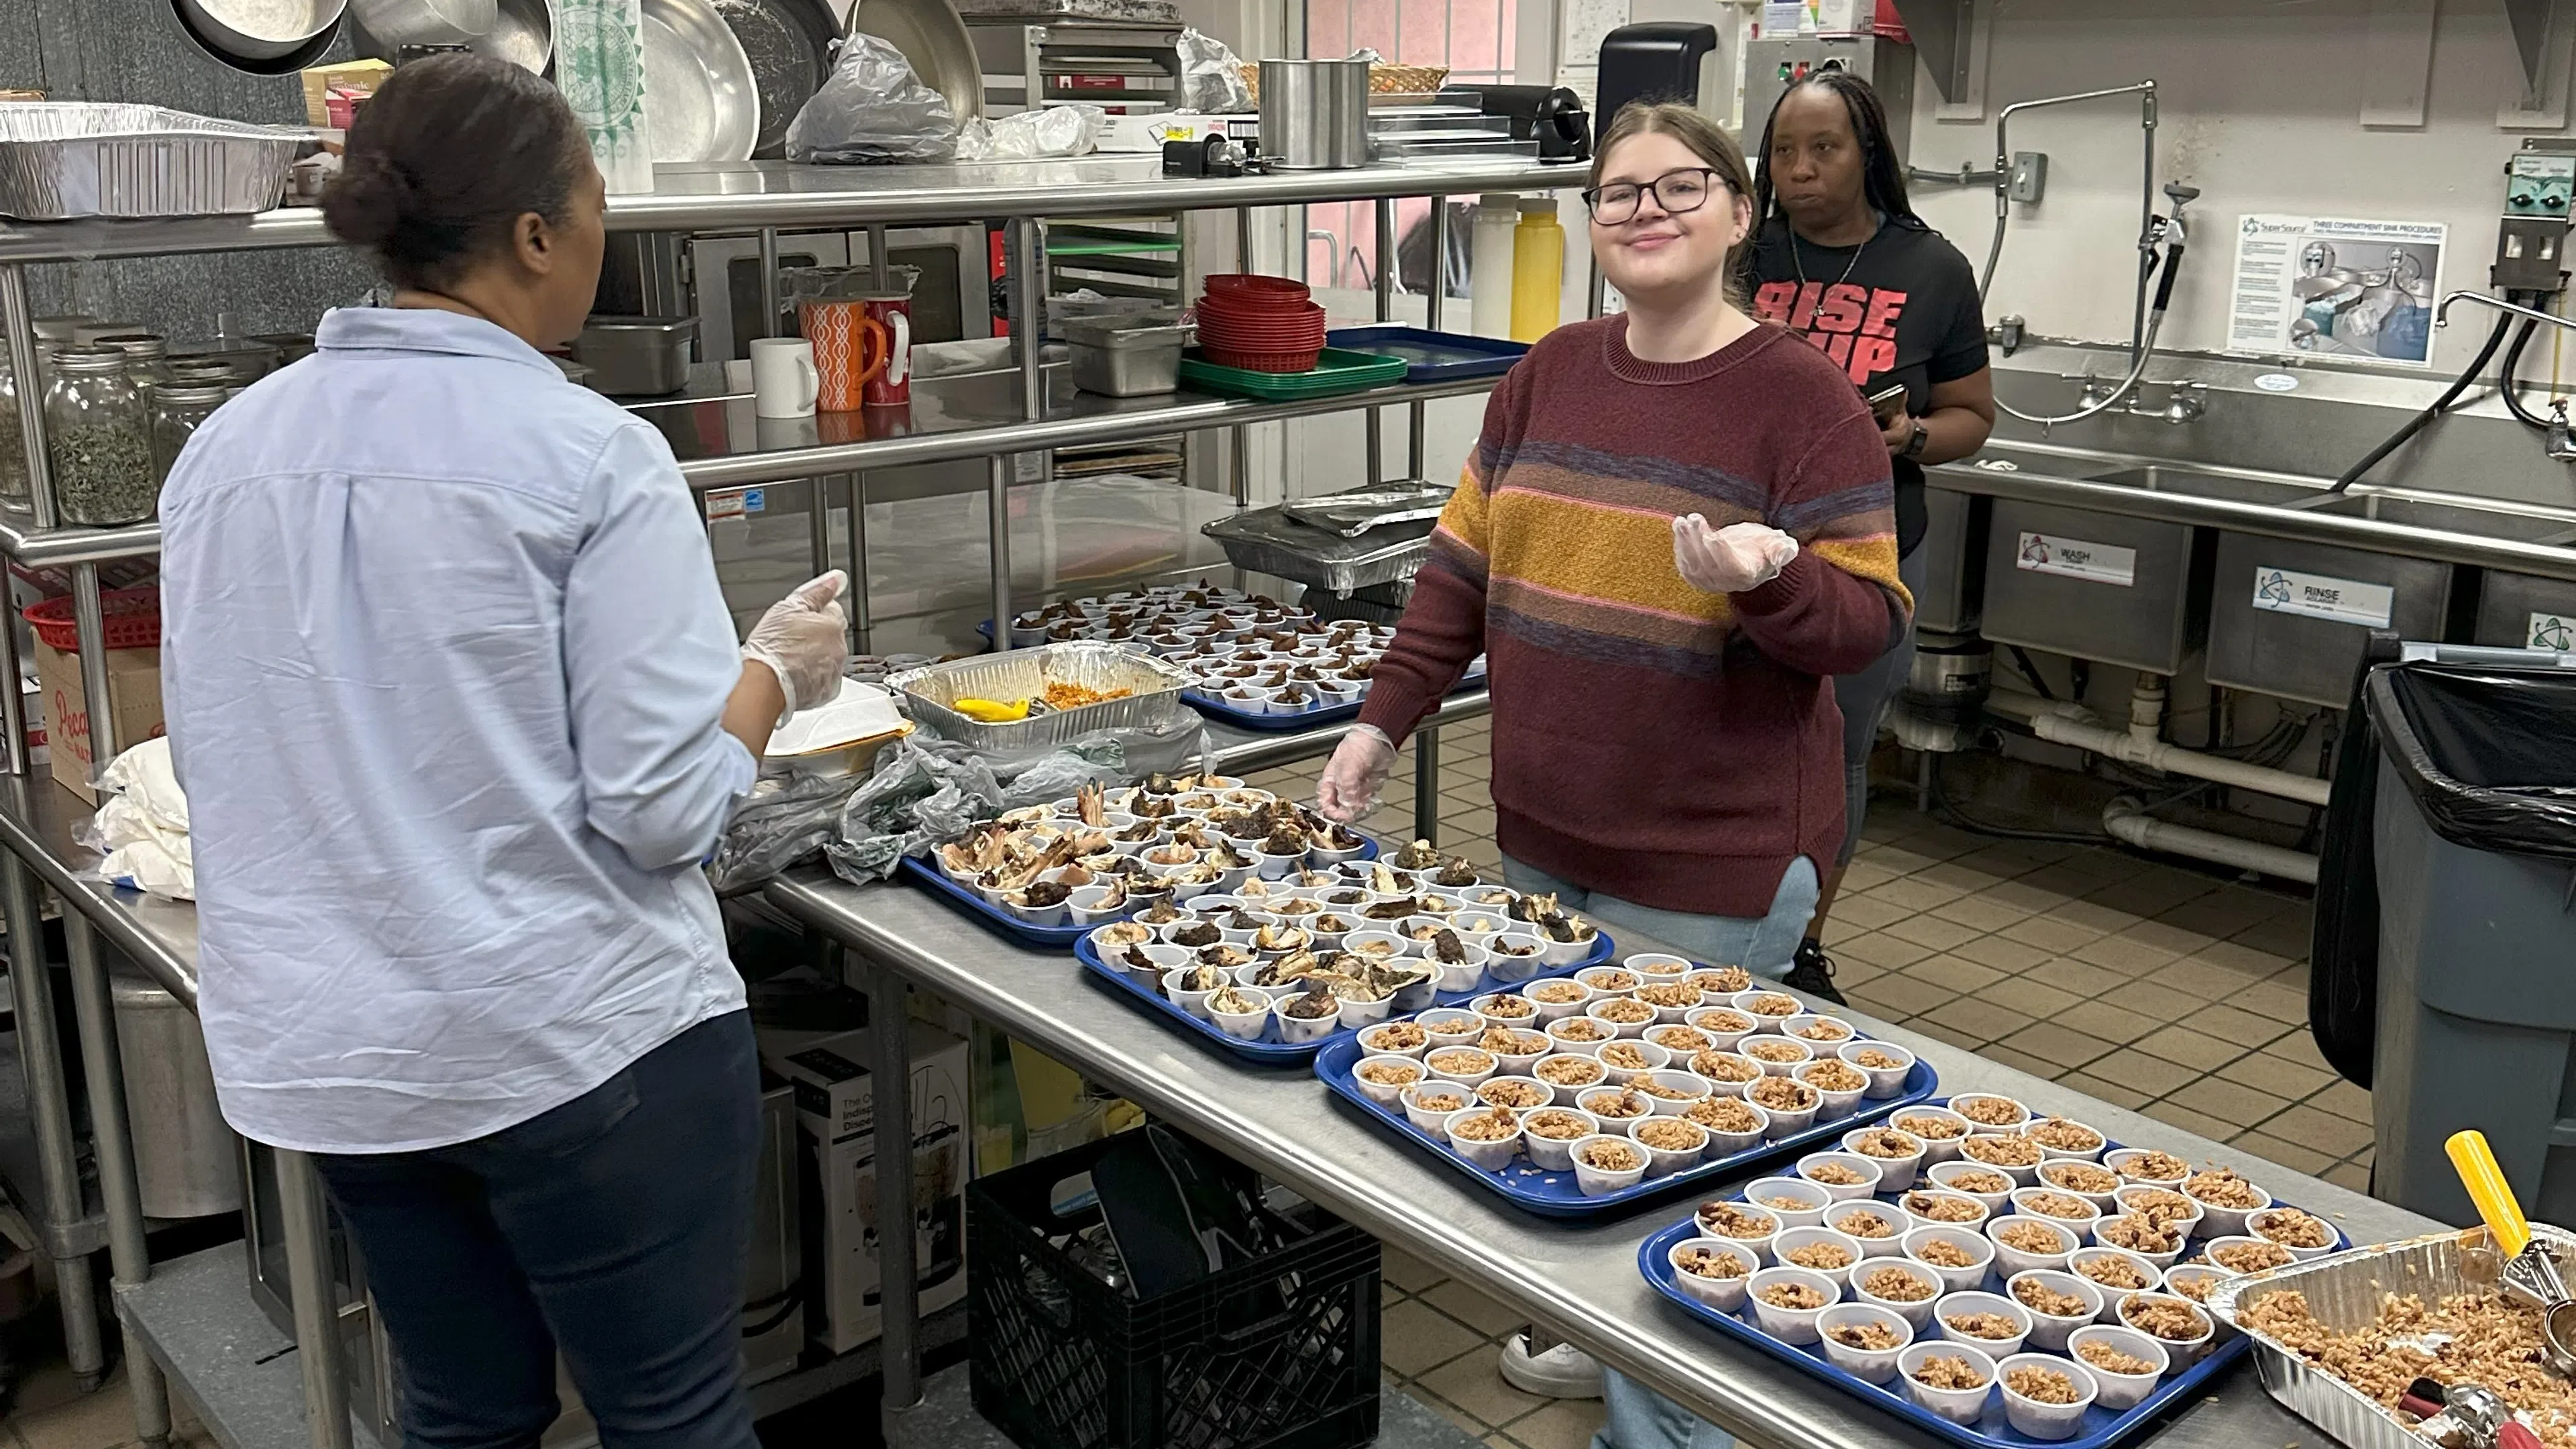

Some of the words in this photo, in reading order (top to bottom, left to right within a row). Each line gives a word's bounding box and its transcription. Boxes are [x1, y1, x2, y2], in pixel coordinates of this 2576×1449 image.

[2314, 221, 2333, 229] THREE
[2334, 222, 2382, 231] COMPARTMENT
[2399, 225, 2443, 233] PROCEDURES
[1754, 280, 1907, 339] RISE
[1807, 332, 1898, 386] UP
[2060, 548, 2091, 561] WASH
[2304, 586, 2340, 600] RINSE
[56, 690, 89, 738] Peca
[843, 1098, 860, 1108] The
[843, 1106, 874, 1120] Indisp
[843, 1117, 874, 1132] Dispe
